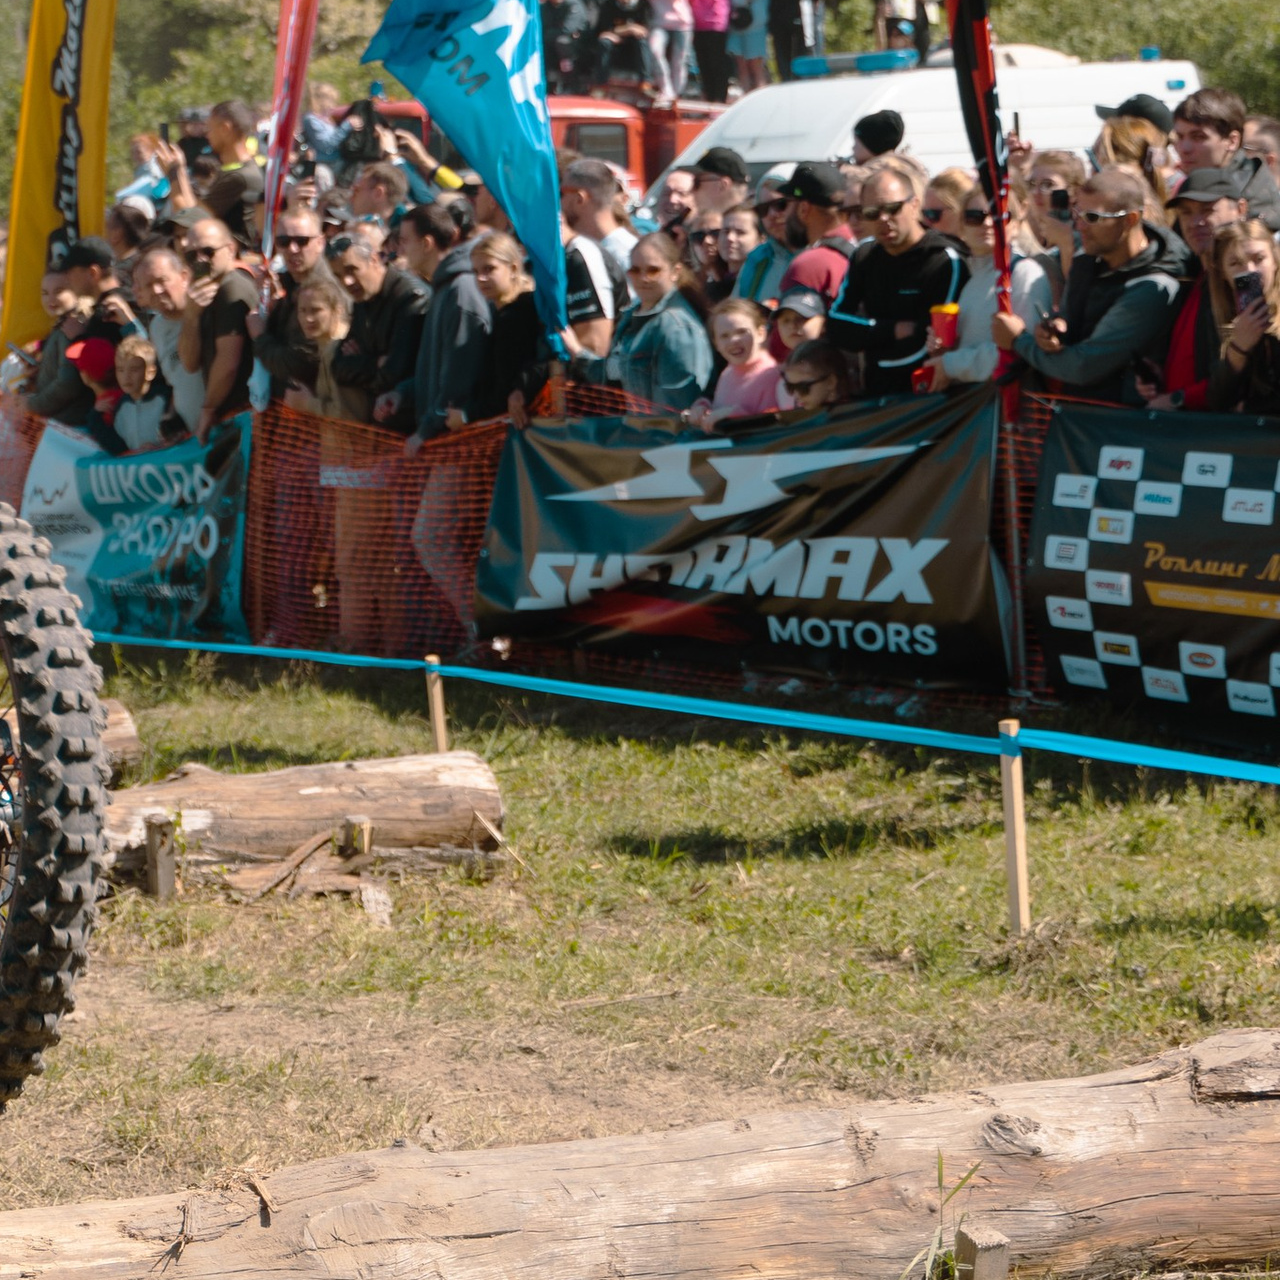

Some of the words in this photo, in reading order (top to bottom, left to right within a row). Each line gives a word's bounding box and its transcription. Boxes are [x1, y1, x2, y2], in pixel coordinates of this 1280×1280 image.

[89, 463, 216, 506] ШКОЛА
[1143, 541, 1249, 578] Роллинг
[767, 616, 938, 656] MOTORS
